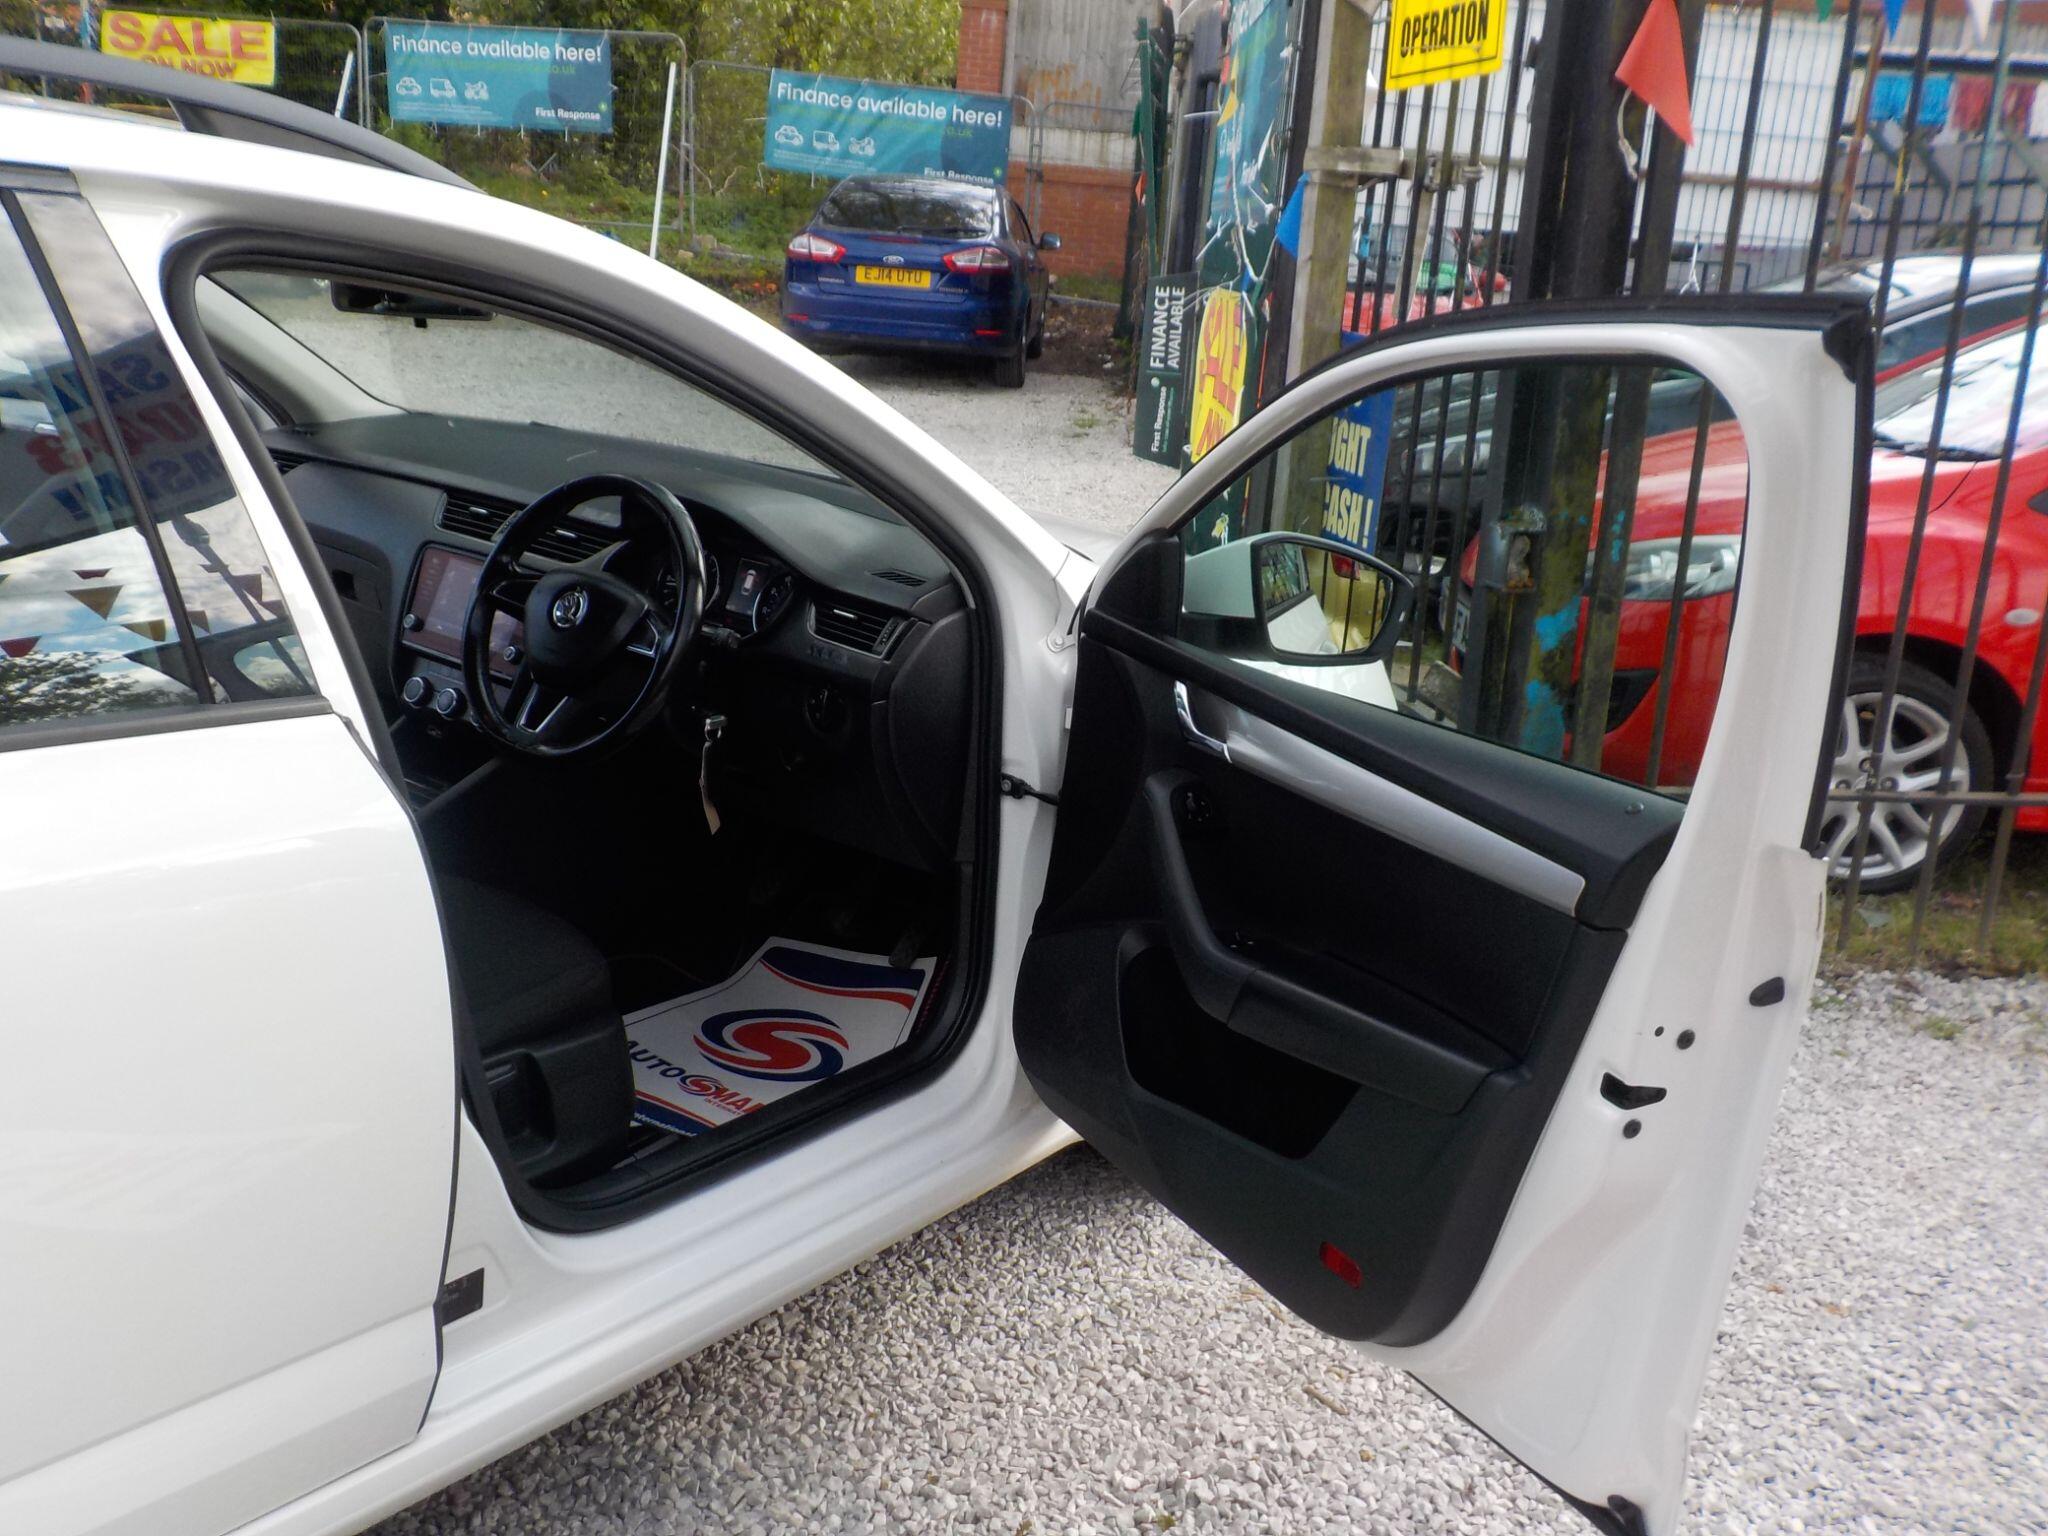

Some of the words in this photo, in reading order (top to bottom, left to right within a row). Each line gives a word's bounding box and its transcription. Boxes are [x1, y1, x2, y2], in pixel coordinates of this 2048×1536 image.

[108, 12, 267, 60] SALE
[1400, 0, 1489, 58] OPERATION
[392, 35, 462, 55] Finance
[467, 39, 550, 60] available
[555, 42, 602, 62] here!
[181, 57, 237, 78] NOW
[535, 107, 556, 118] First
[557, 108, 600, 121] Response
[777, 82, 852, 108] Finance
[857, 96, 947, 121] available
[952, 104, 1002, 127] here!
[924, 167, 945, 178] First
[864, 267, 892, 280] EJ14
[897, 270, 922, 284] UTU
[1150, 285, 1170, 368] FINANCE
[1167, 286, 1186, 369] AVAILABLE
[1154, 386, 1168, 430] Response
[1151, 431, 1161, 453] First
